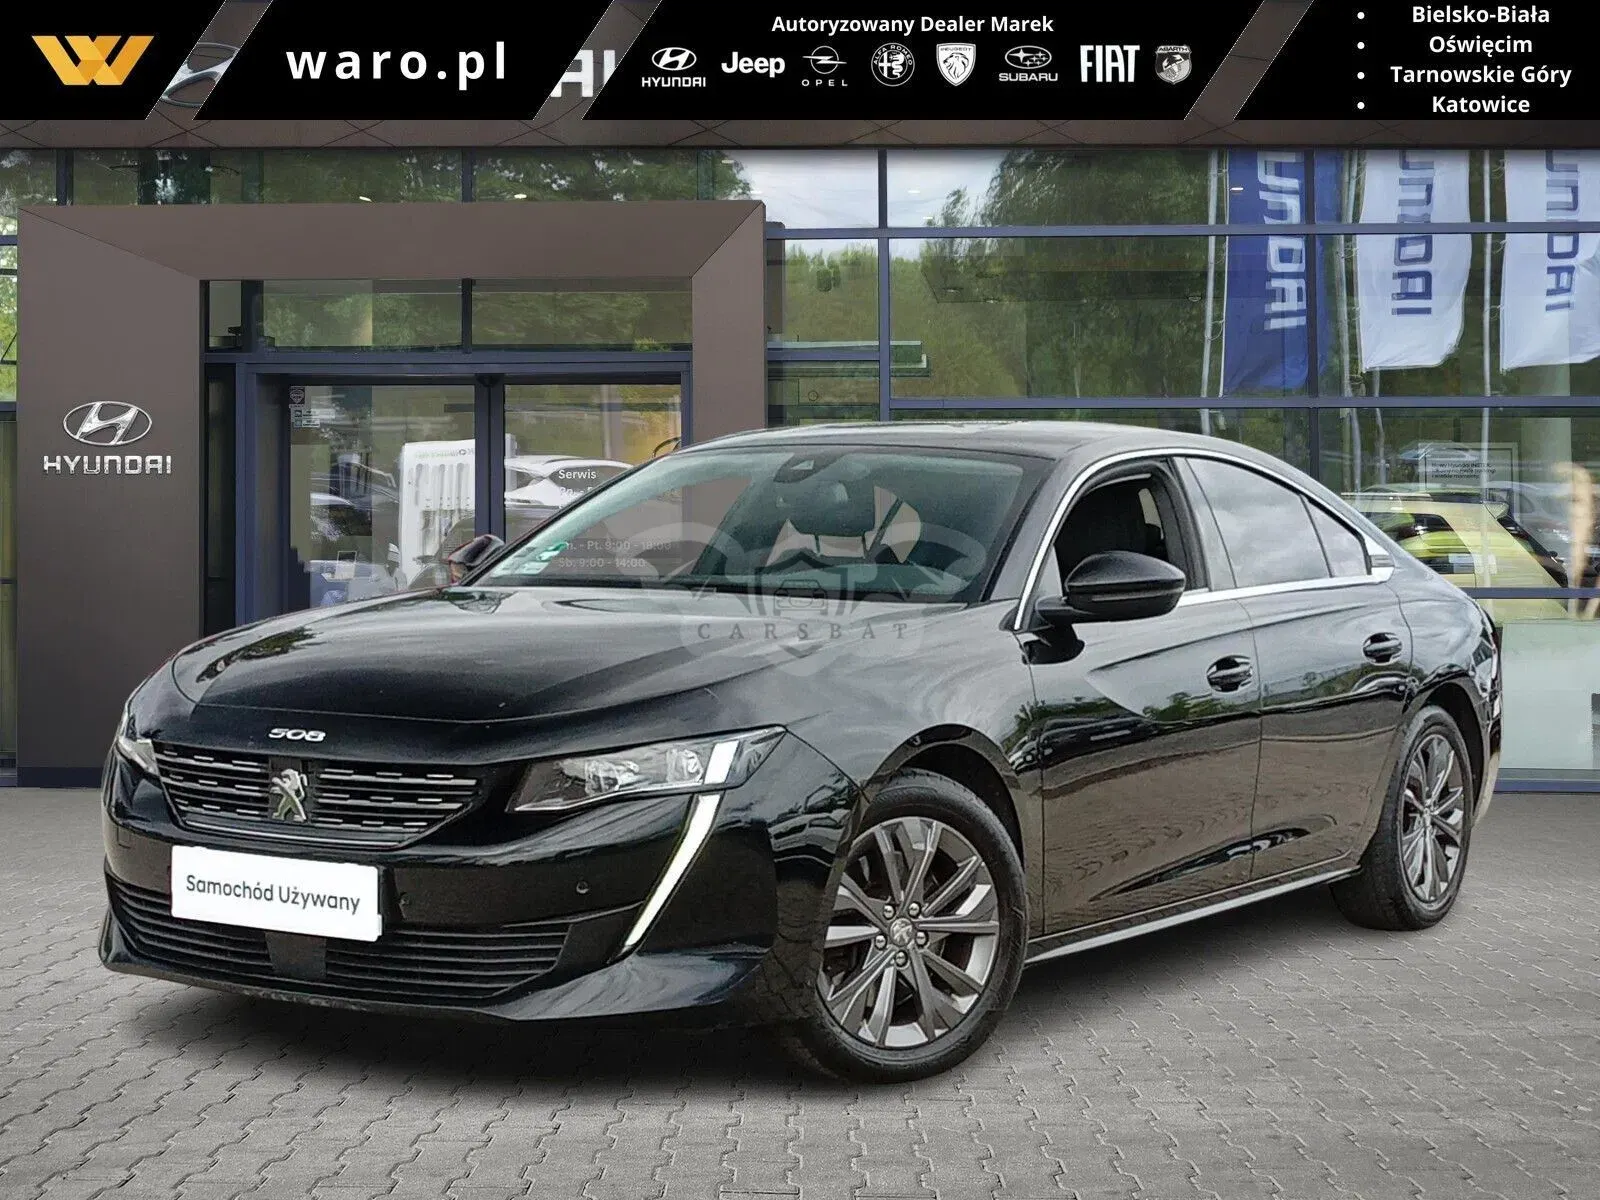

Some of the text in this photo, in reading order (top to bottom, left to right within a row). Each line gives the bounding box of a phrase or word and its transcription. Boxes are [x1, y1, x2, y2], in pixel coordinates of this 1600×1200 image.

[43, 455, 172, 475] HYUNDAI
[558, 469, 597, 480] Serwis
[268, 727, 327, 742] 508
[186, 874, 361, 916] Samochód Używany
